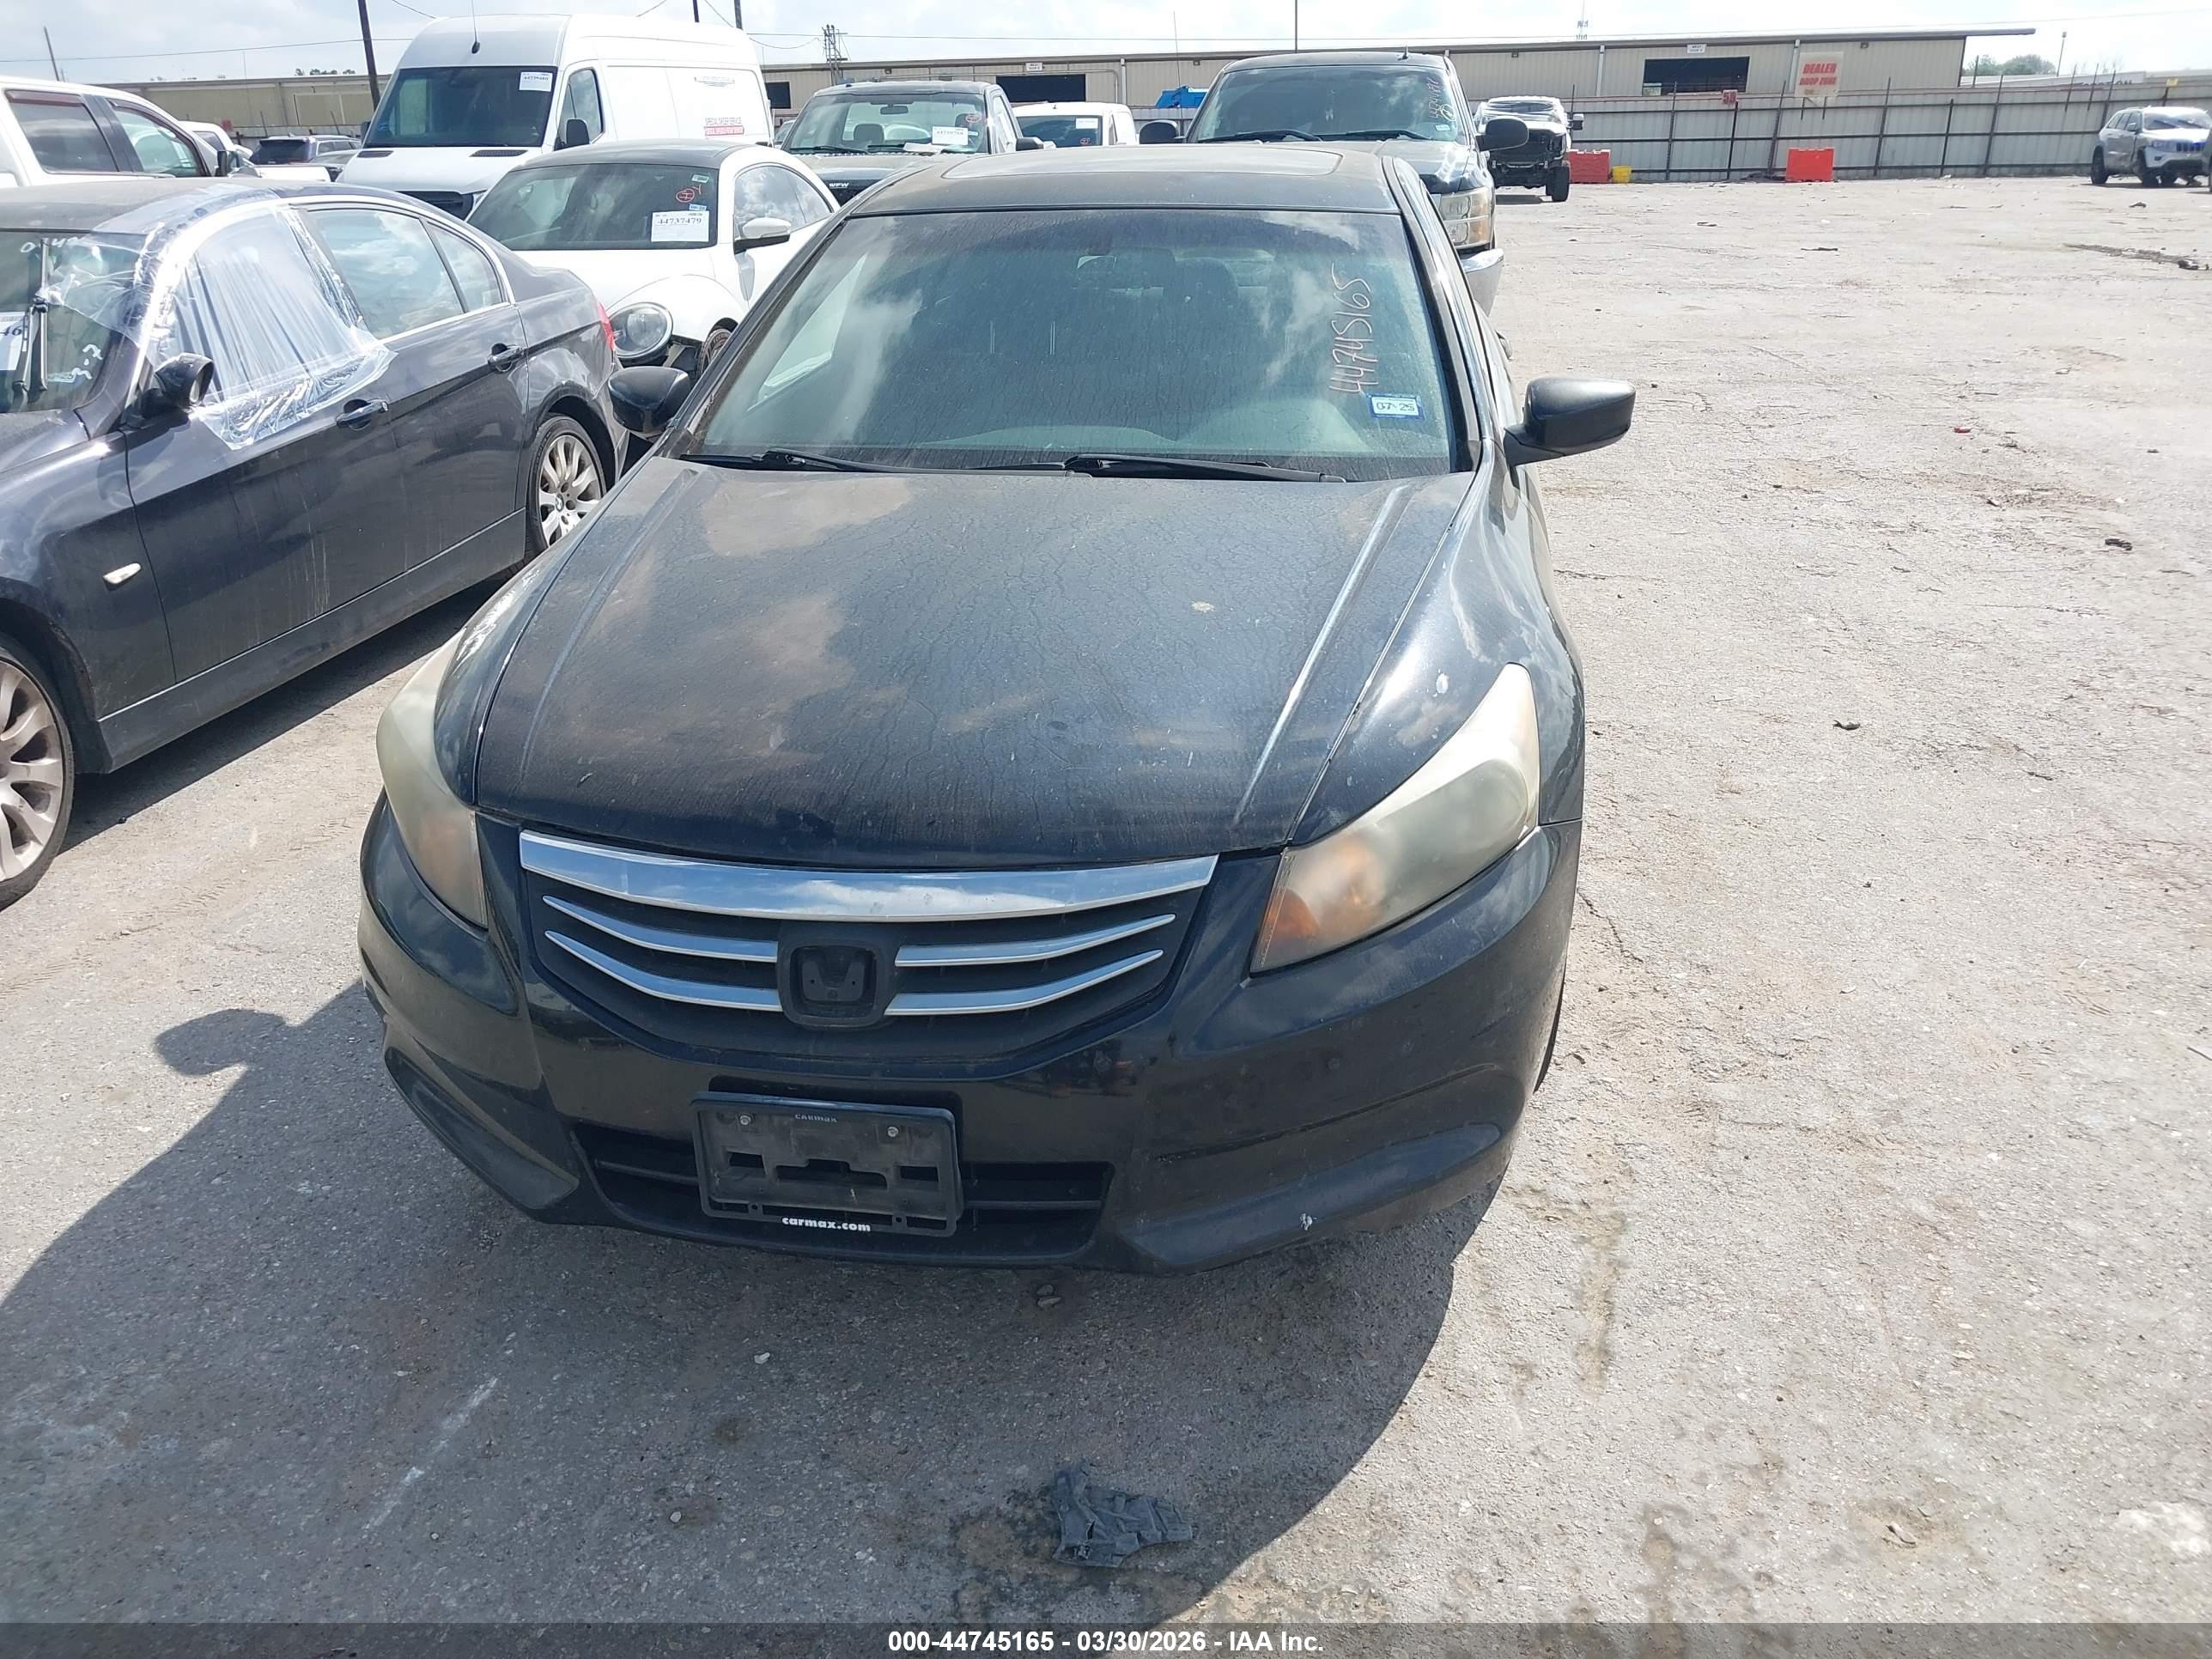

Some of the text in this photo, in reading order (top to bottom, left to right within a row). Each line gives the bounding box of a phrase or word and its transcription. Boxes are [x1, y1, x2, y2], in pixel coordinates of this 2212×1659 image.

[1802, 63, 1838, 74] DEALER
[1799, 76, 1838, 86] DROP ZONE
[1329, 262, 1379, 394] 44745165
[781, 1216, 871, 1232] carmax.com
